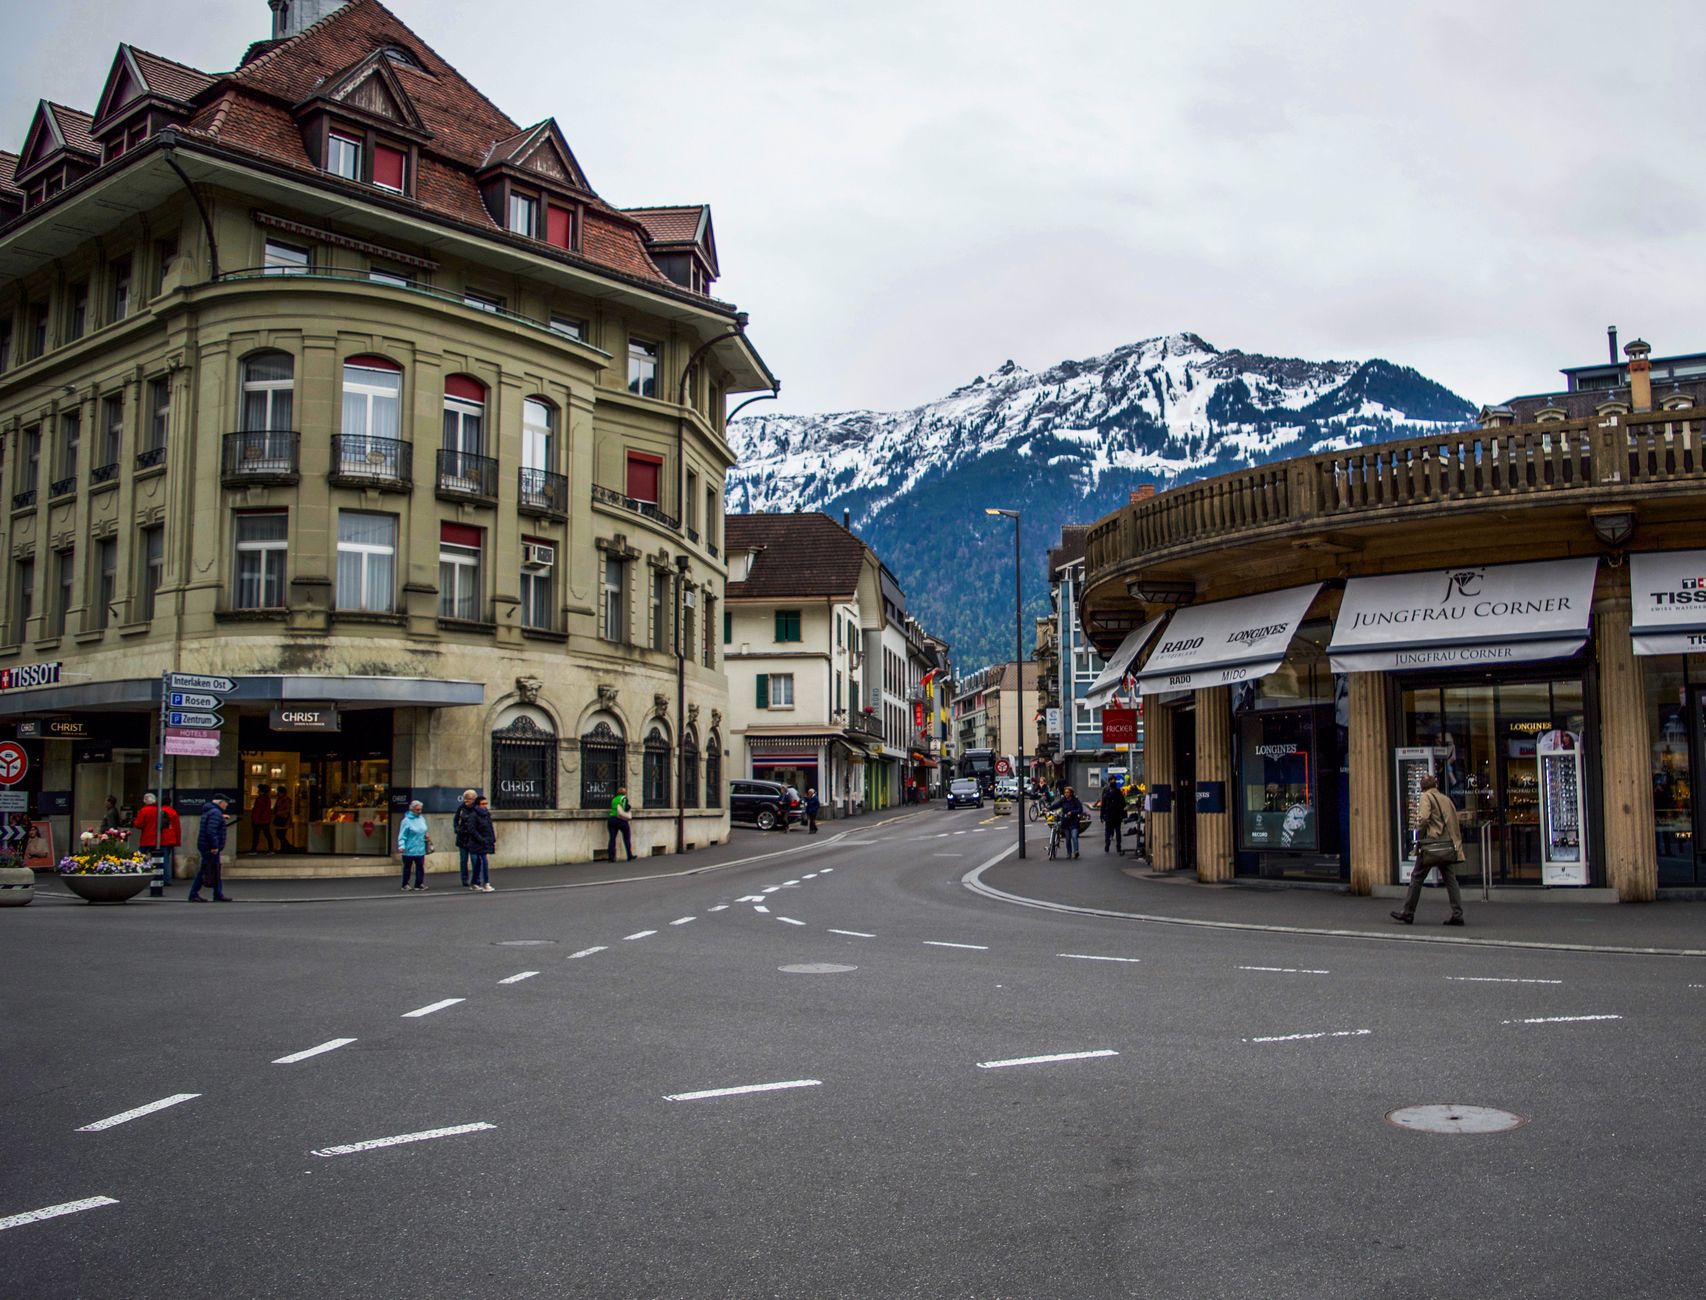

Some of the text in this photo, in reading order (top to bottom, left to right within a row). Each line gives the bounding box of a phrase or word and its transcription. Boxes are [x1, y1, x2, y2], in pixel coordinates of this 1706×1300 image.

[1352, 597, 1572, 630] JUNGFRAU CORNER
[1226, 623, 1289, 643] LONGINES
[1161, 637, 1204, 654] RADO
[1395, 648, 1512, 666] JUNGFRAU CORNER
[10, 662, 58, 688] TISSOT
[1169, 675, 1191, 686] RADO
[1221, 669, 1247, 681] MIDO
[174, 676, 226, 689] Interlaken Ost
[185, 696, 211, 706] Rosen
[183, 715, 212, 724] Zentrum
[282, 712, 320, 722] CHRIST
[50, 722, 84, 731] CHRIST
[1106, 724, 1133, 733] FRICKER
[1510, 722, 1552, 731] LONGINES
[180, 730, 208, 738] HOTELS
[1255, 744, 1298, 755] LONGINES
[501, 780, 536, 792] CHRIST
